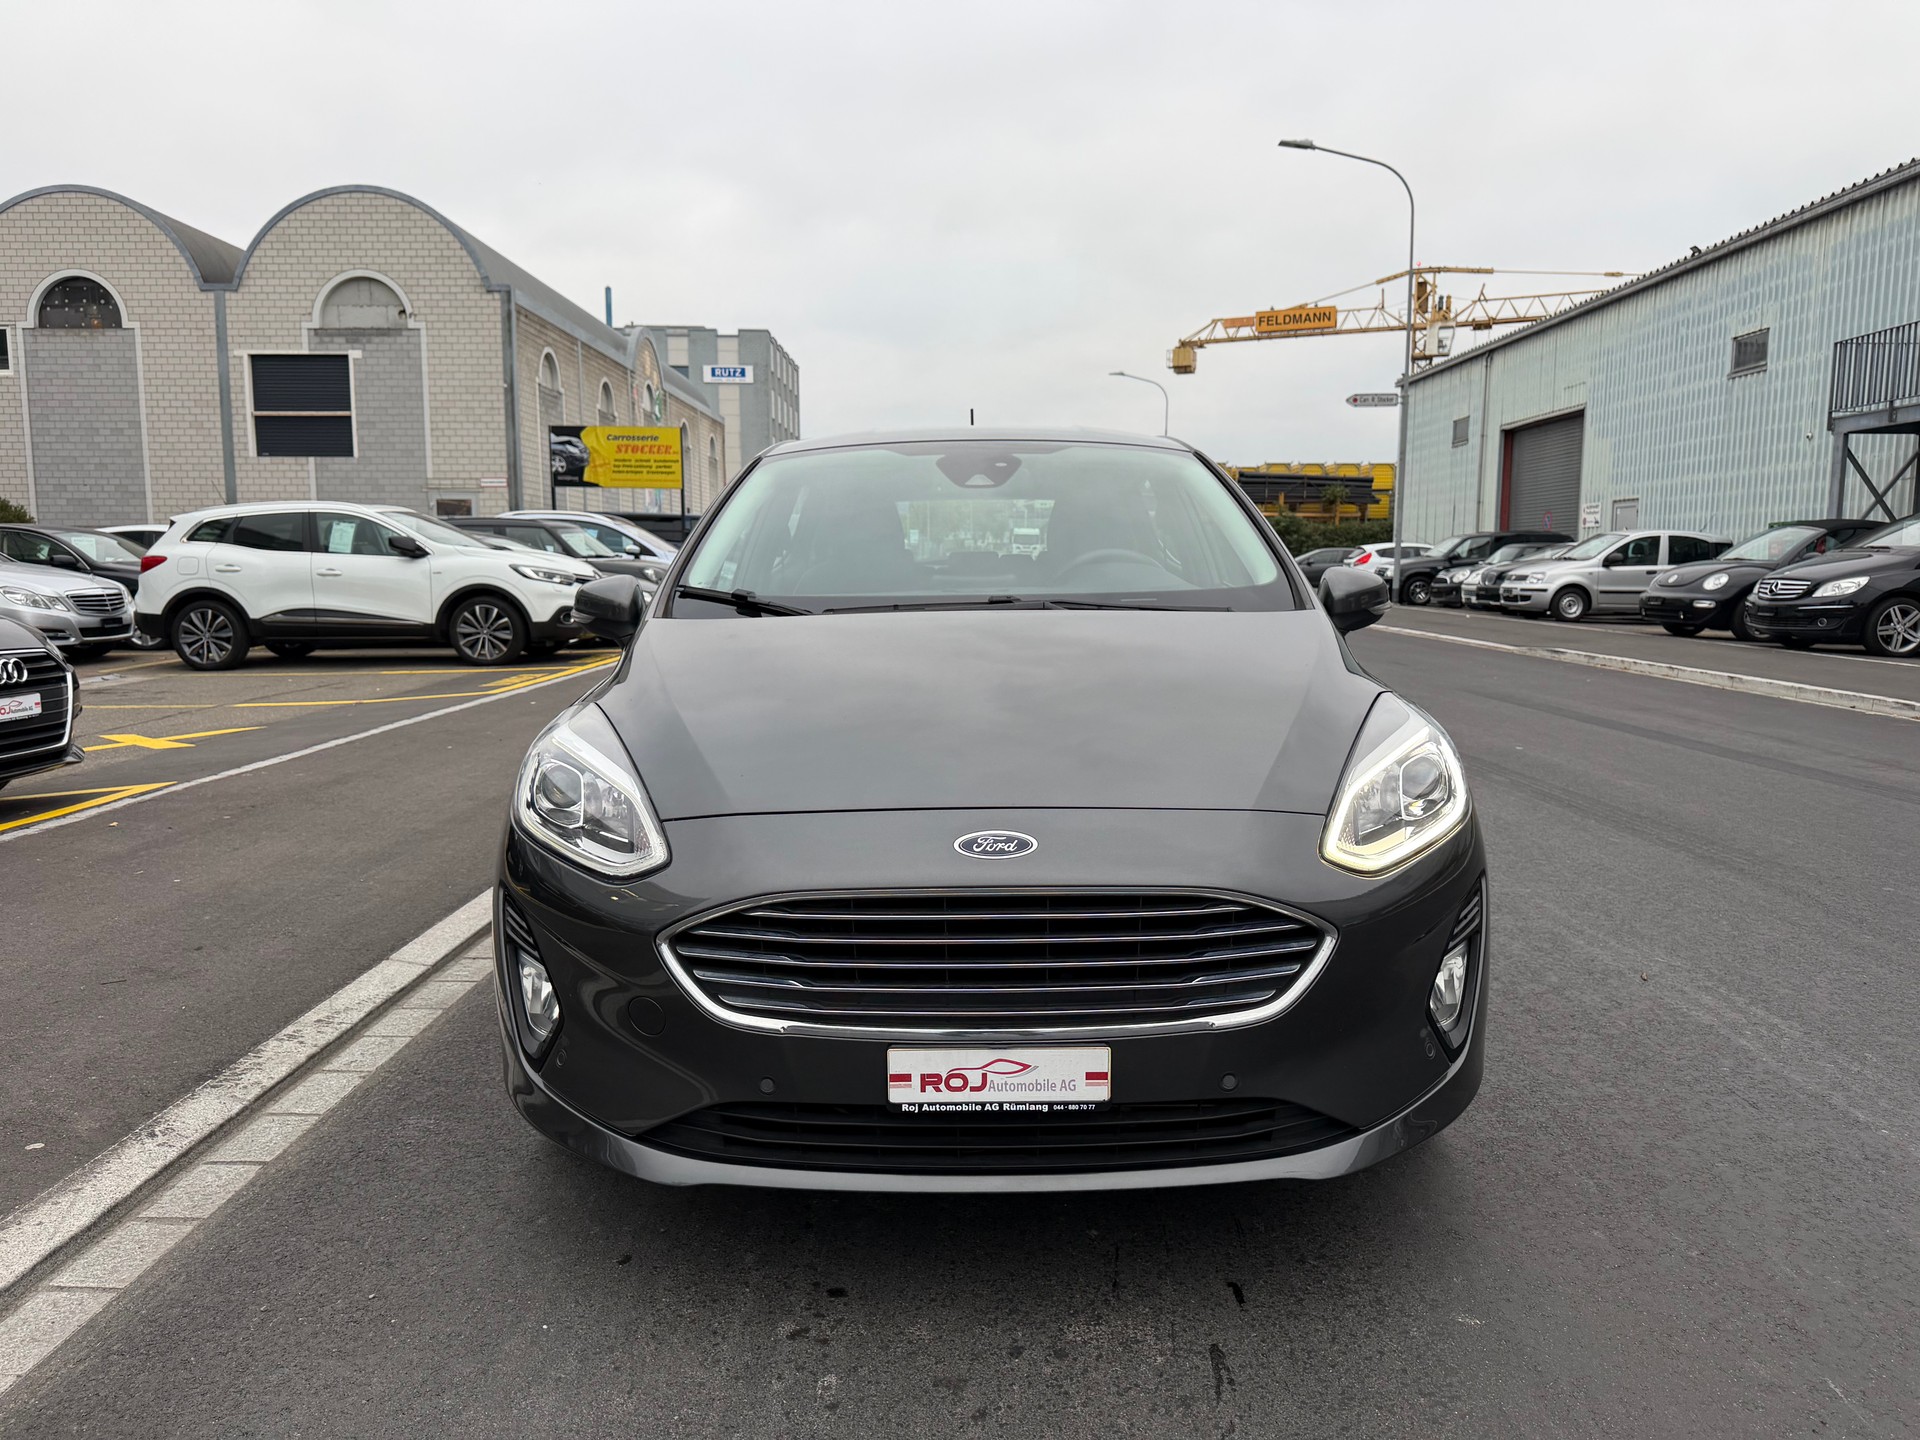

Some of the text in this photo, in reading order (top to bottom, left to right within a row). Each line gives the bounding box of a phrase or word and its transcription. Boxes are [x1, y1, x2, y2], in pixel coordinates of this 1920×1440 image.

[1258, 311, 1332, 327] FELDMANN
[714, 368, 742, 377] RUTZ
[606, 434, 659, 442] Carrosserie
[615, 444, 672, 455] STOCKER
[973, 836, 1018, 852] Ford
[920, 1072, 1077, 1093] ROJ Automobile AG
[901, 1103, 919, 1113] Roj
[922, 1103, 982, 1112] Automobile
[984, 1103, 1000, 1112] AG
[1002, 1102, 1049, 1113] Rümlang
